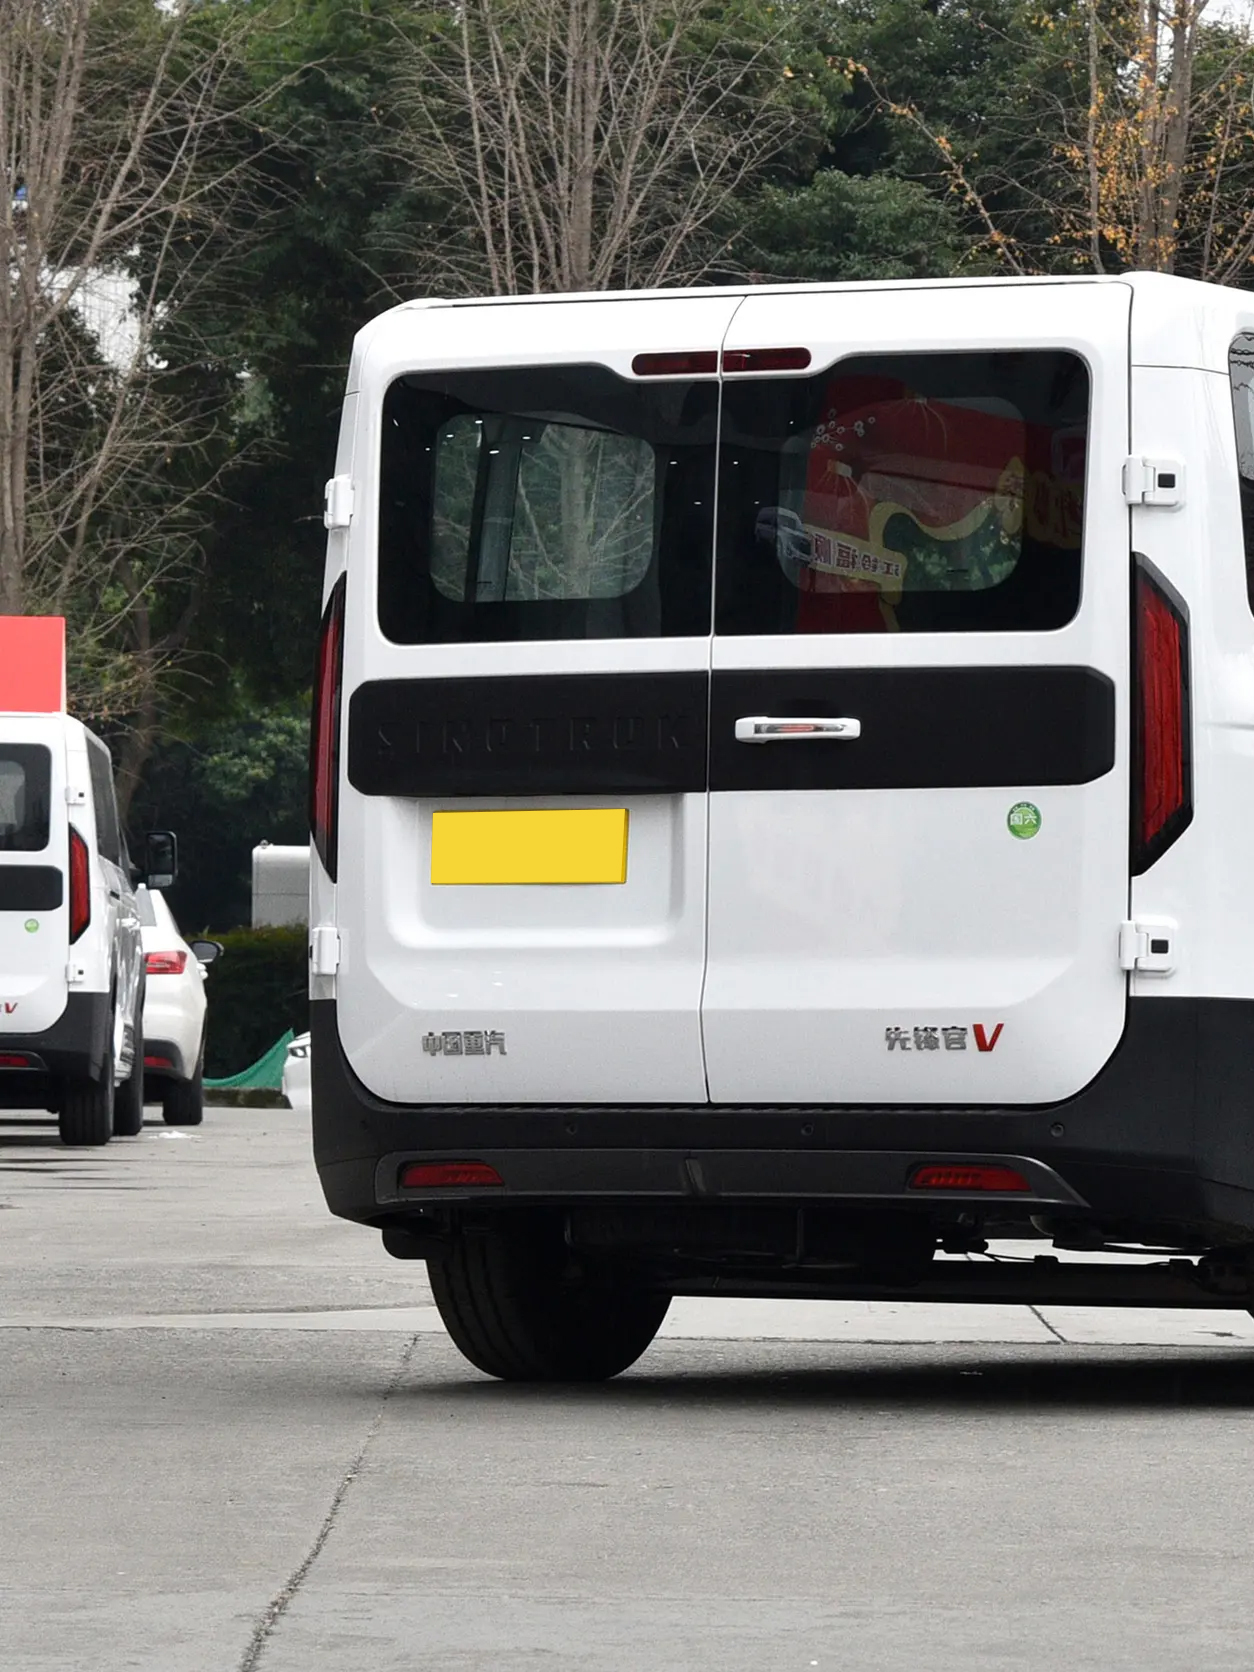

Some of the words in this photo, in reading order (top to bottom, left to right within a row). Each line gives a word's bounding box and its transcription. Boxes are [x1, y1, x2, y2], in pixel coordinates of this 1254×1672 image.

[377, 716, 690, 753] SINOTRUK
[421, 1030, 507, 1056] 中国重汽
